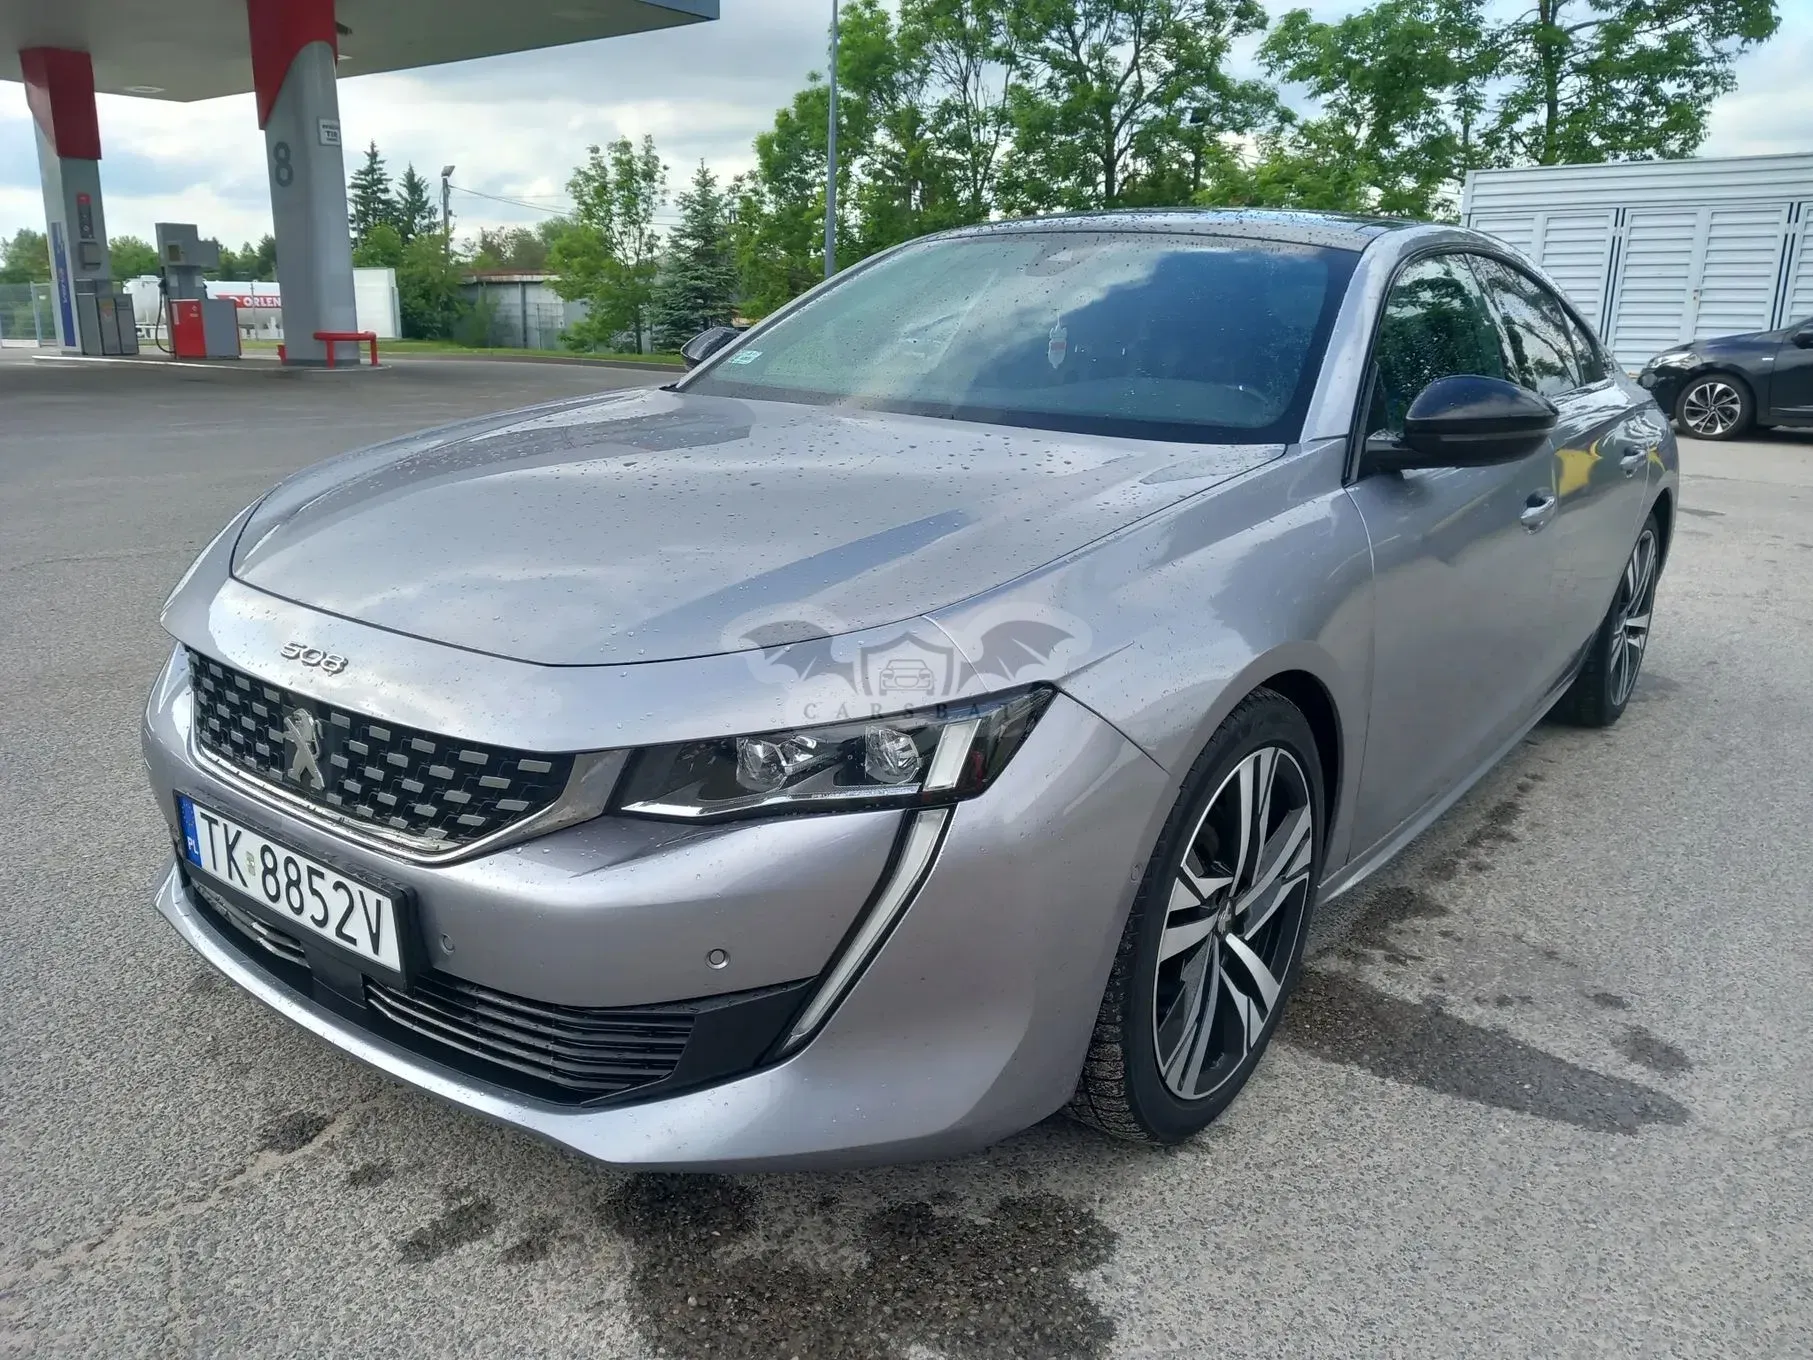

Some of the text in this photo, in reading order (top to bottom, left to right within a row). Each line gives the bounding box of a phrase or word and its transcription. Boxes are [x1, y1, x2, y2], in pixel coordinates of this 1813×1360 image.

[273, 141, 294, 187] 8
[243, 296, 281, 307] ORLEN
[280, 641, 348, 676] 508
[186, 835, 199, 855] PL
[200, 811, 382, 956] TK 8852V
